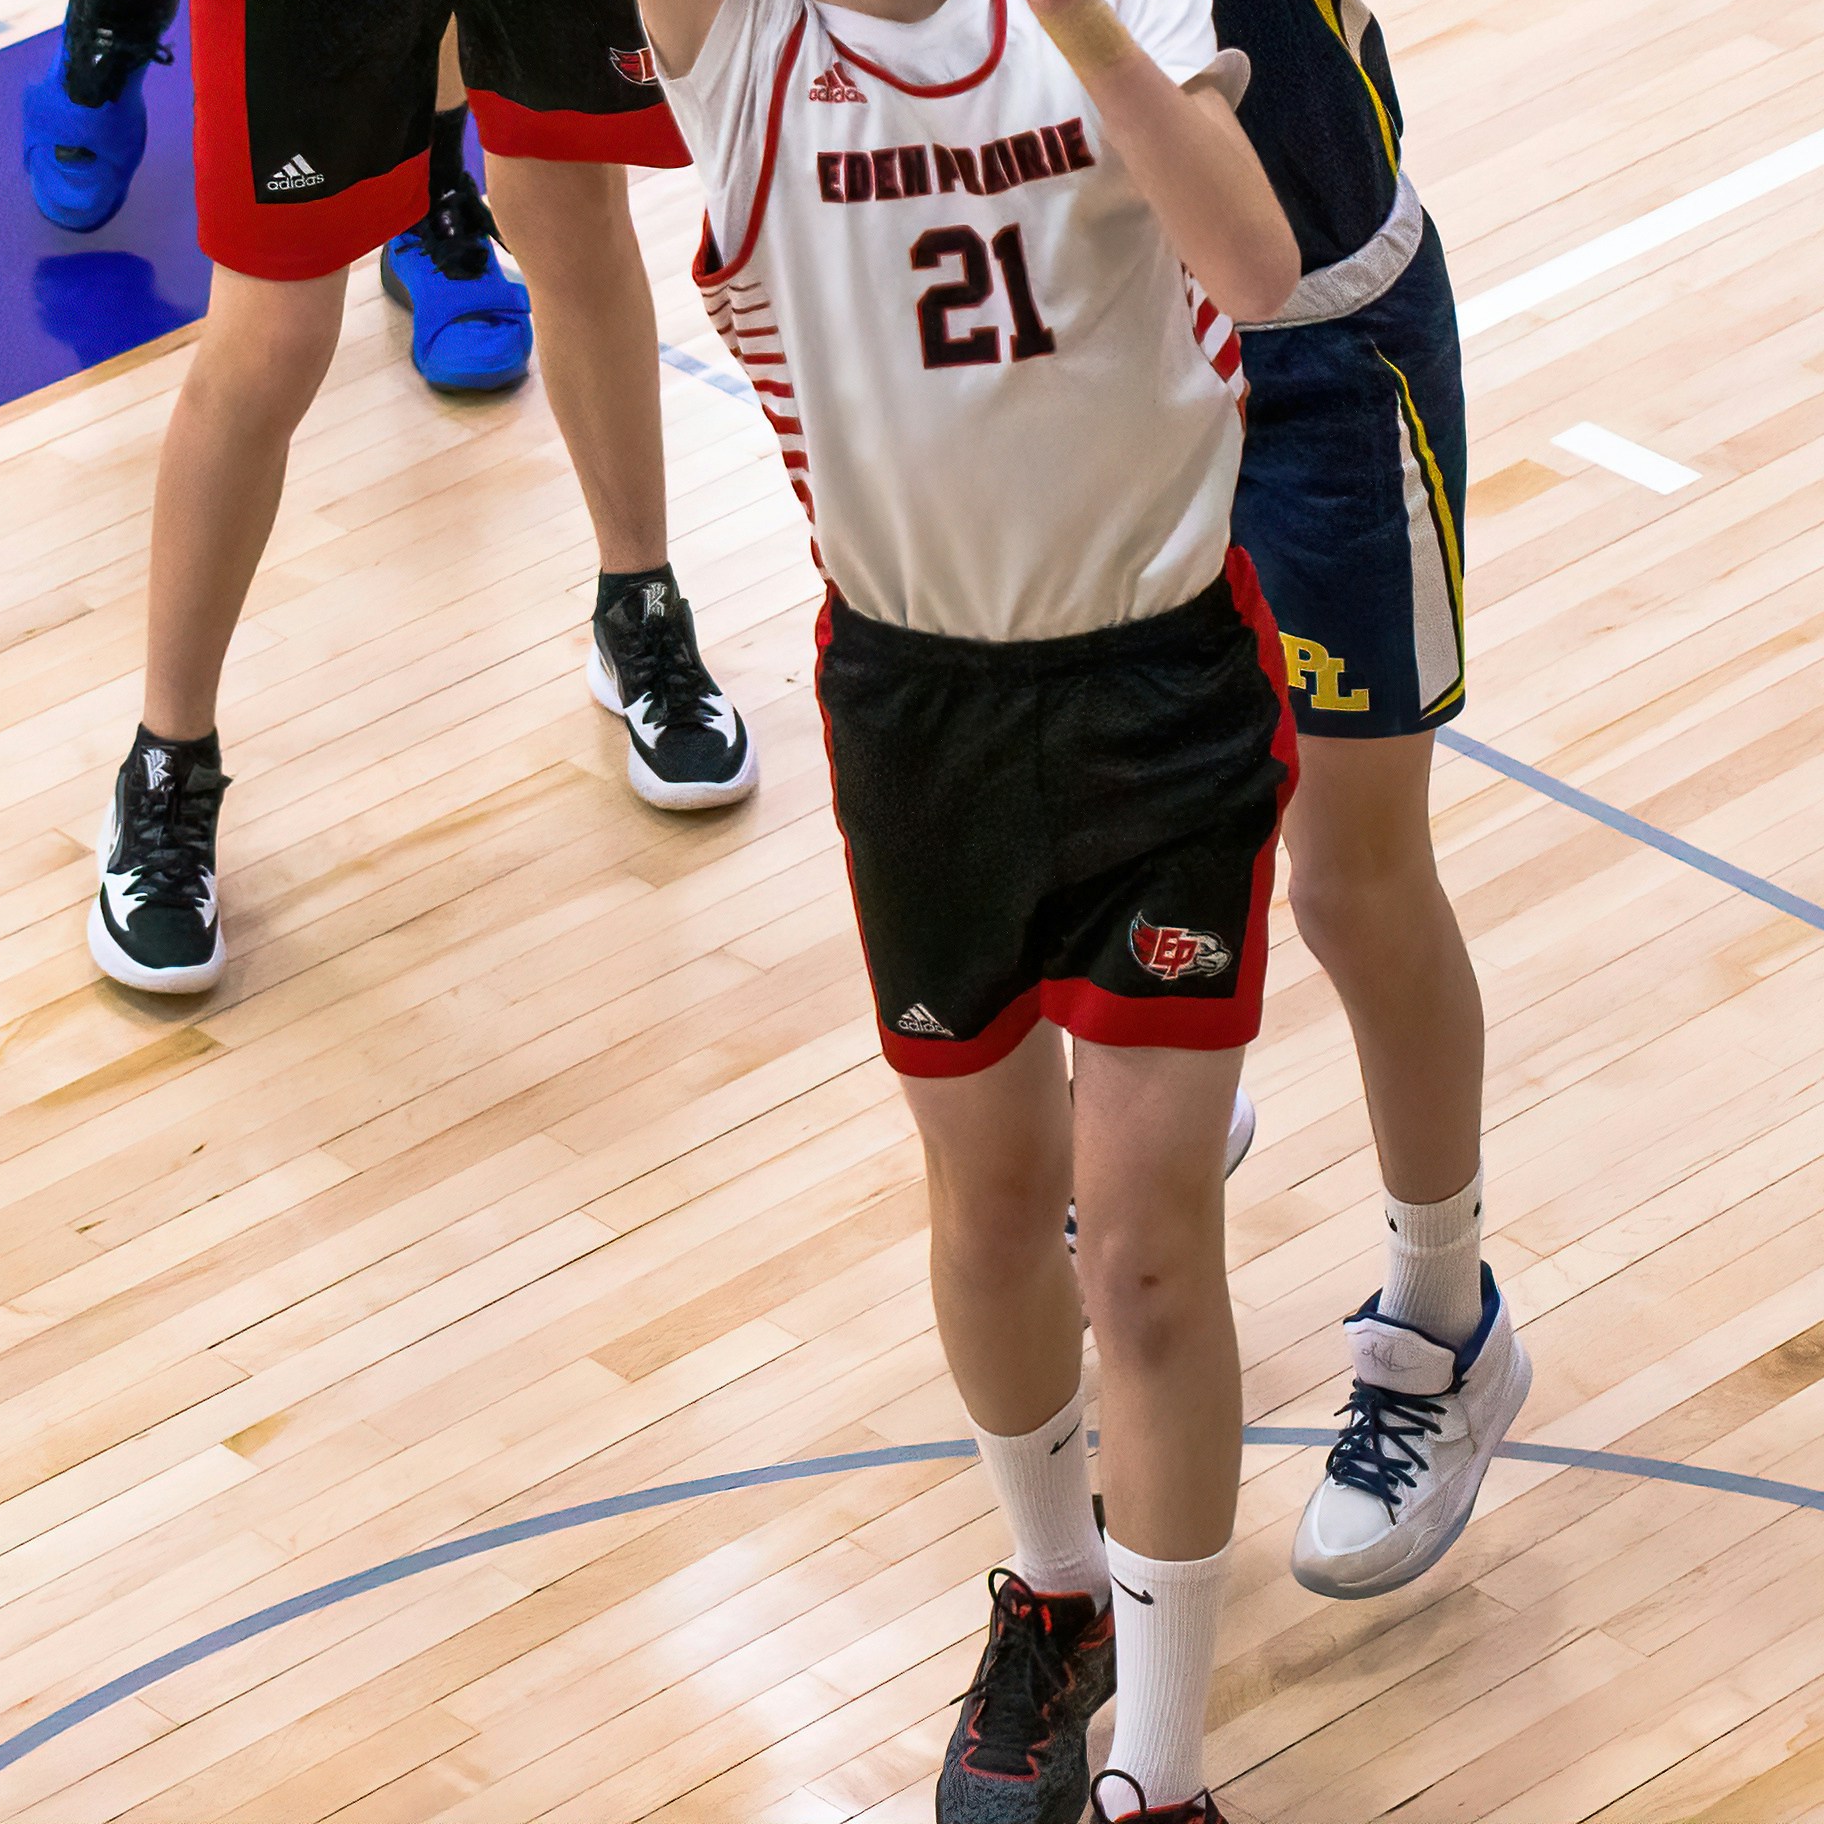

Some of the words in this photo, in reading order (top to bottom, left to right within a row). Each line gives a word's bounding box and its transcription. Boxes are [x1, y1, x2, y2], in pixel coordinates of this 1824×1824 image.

[267, 174, 325, 191] adidas
[816, 143, 932, 203] EDEN
[909, 222, 1056, 370] 21
[1278, 630, 1370, 712] PL
